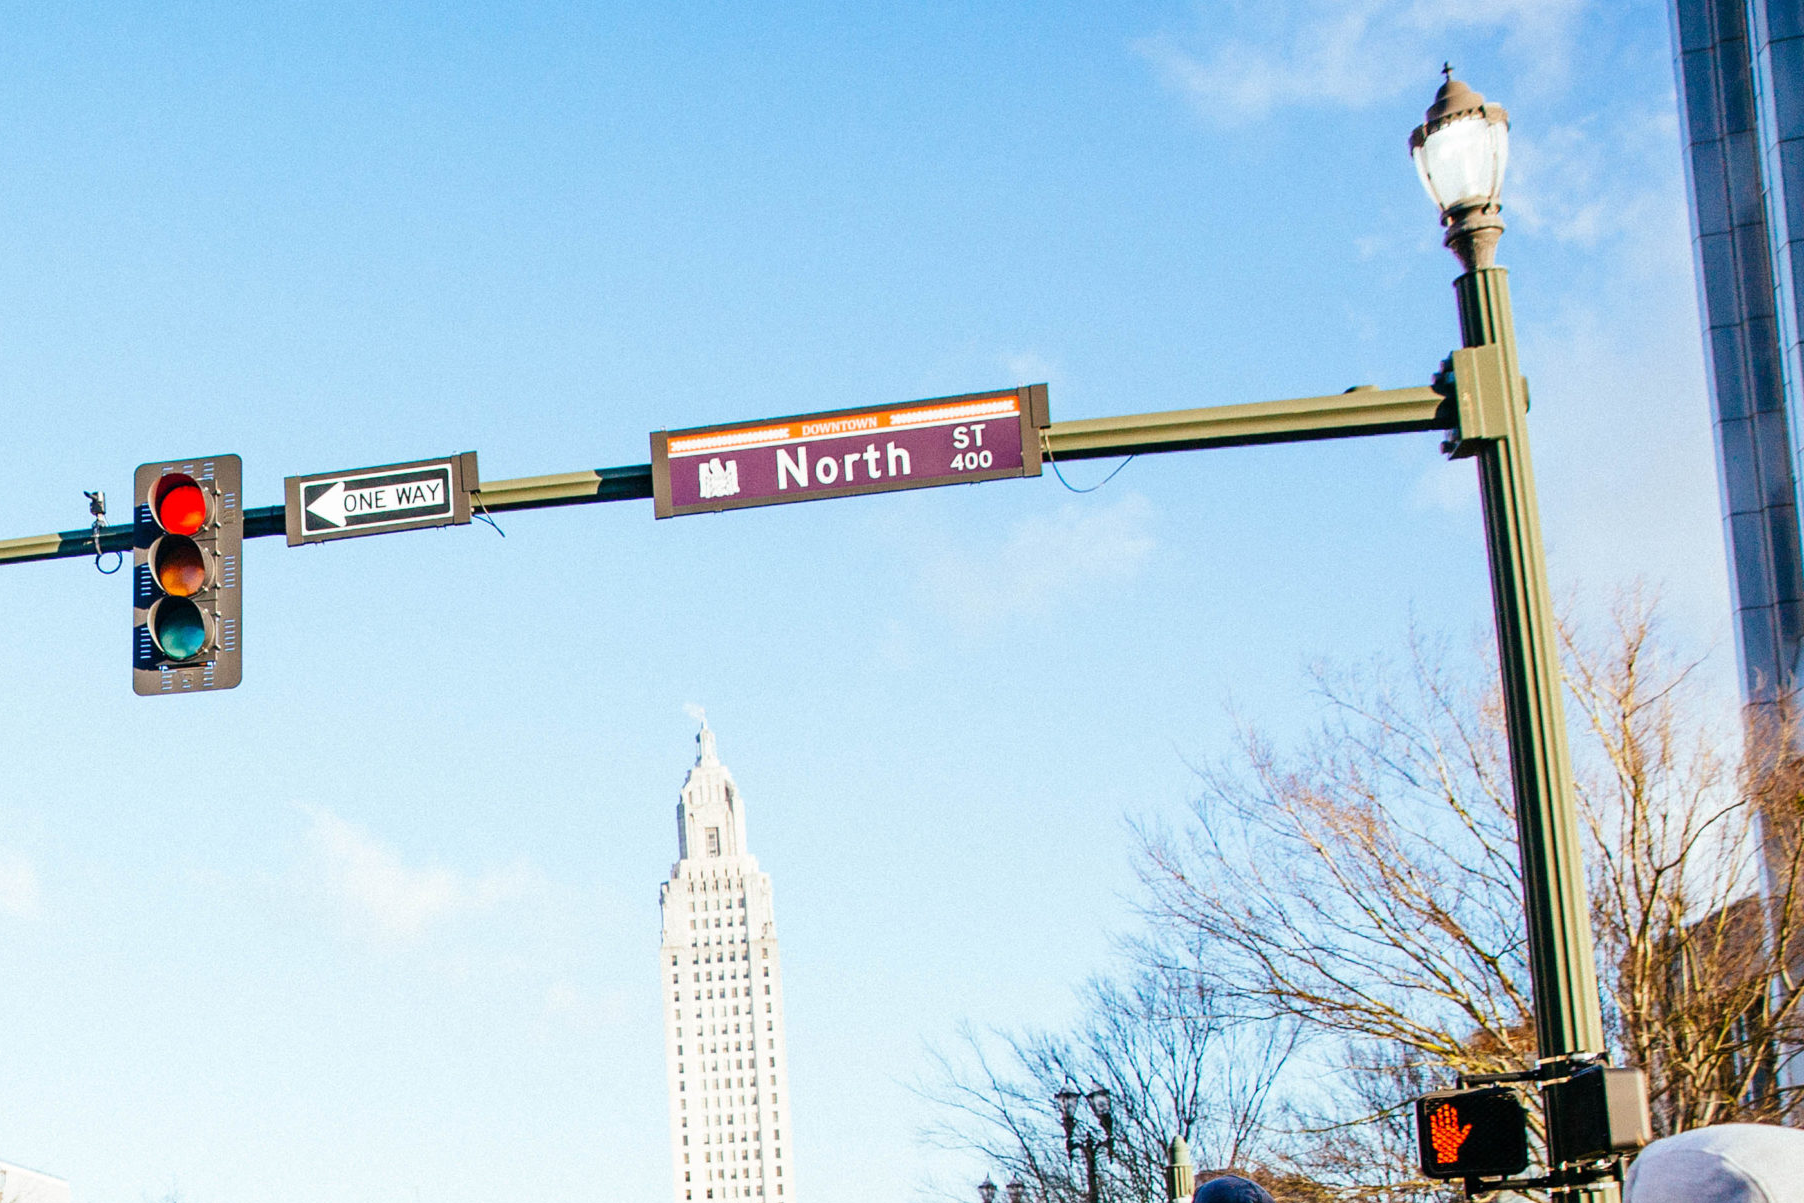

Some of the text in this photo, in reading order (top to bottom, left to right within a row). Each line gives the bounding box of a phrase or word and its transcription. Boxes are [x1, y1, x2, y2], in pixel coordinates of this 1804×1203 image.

[802, 417, 878, 436] DOWNTOWN
[775, 424, 987, 490] North ST
[950, 450, 993, 471] 400
[344, 483, 440, 513] ONE WAY
